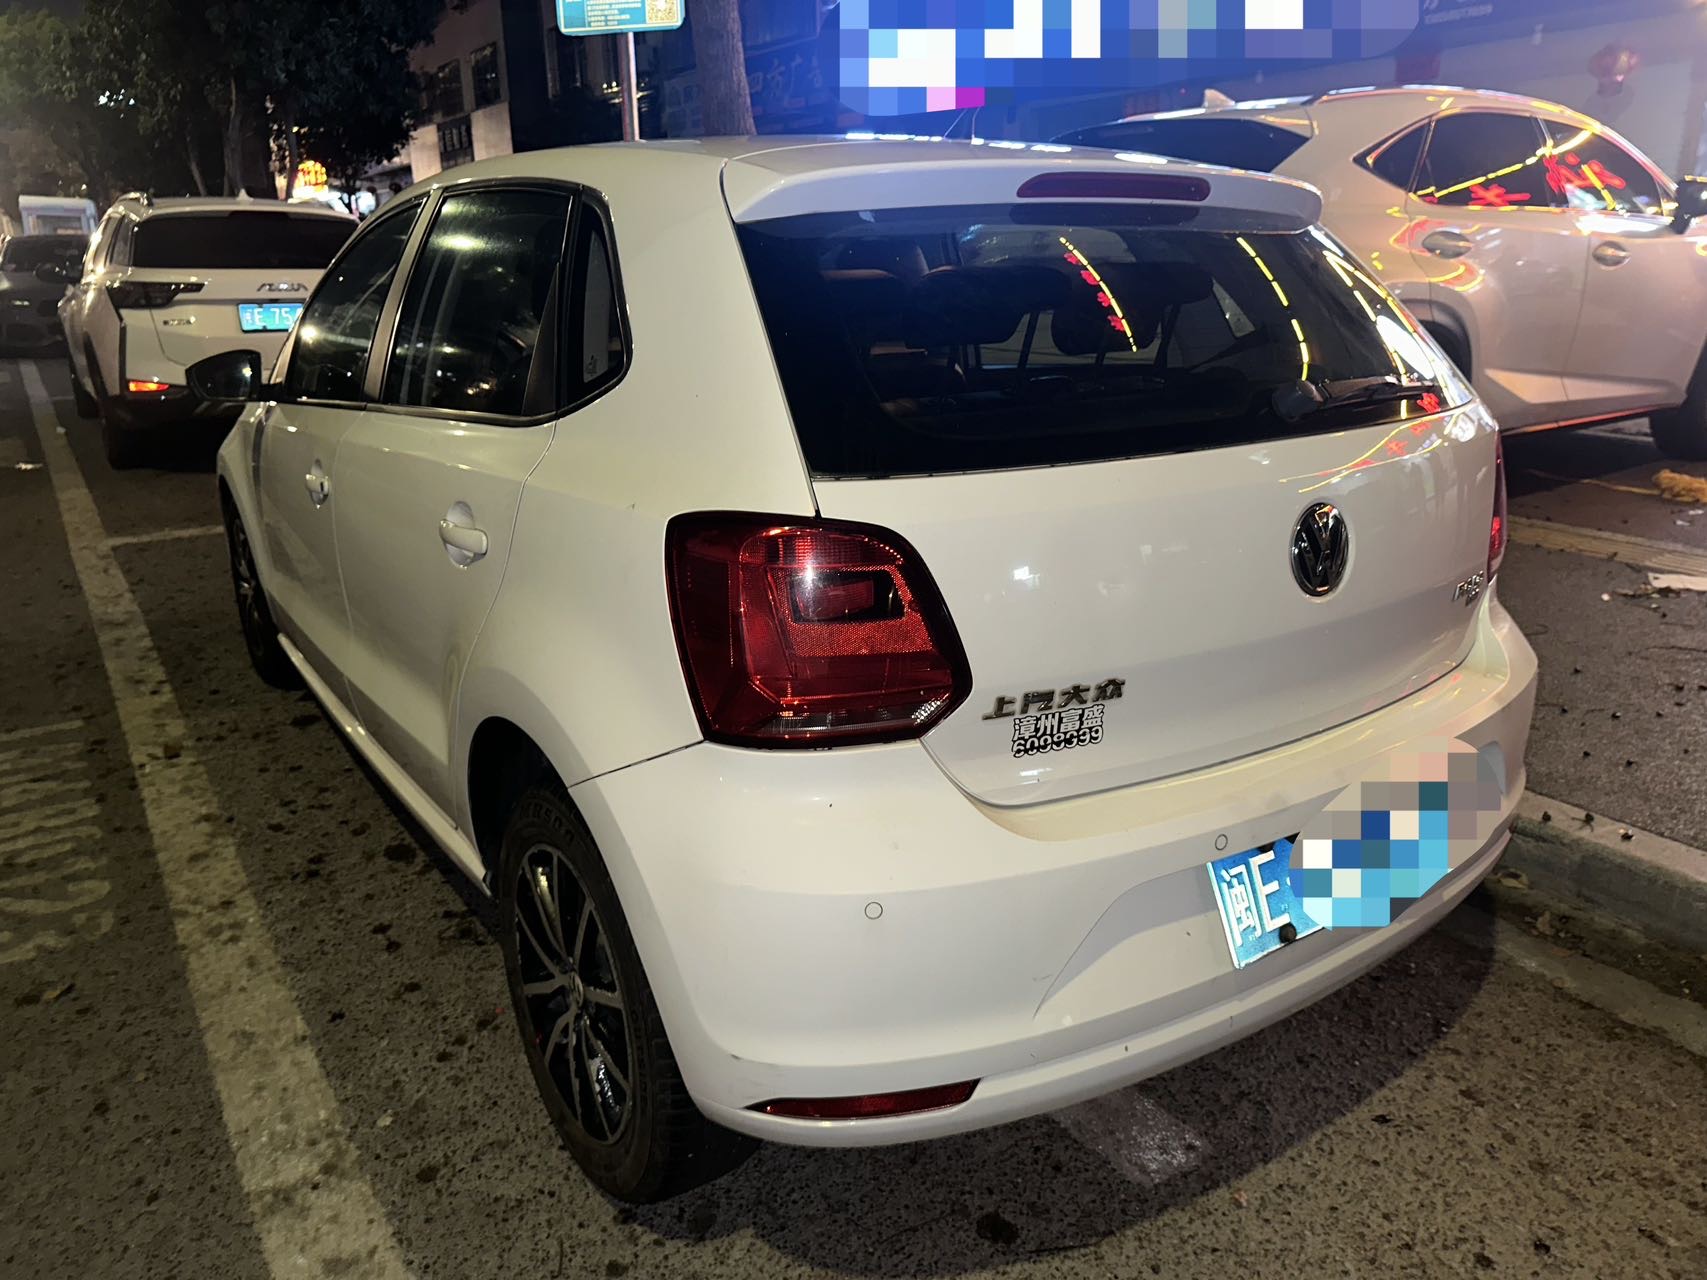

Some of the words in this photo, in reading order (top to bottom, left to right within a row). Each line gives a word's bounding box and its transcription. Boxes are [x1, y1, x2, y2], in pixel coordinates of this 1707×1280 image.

[982, 679, 1126, 720] 上汽大众
[1012, 704, 1105, 741] 漳州富盛
